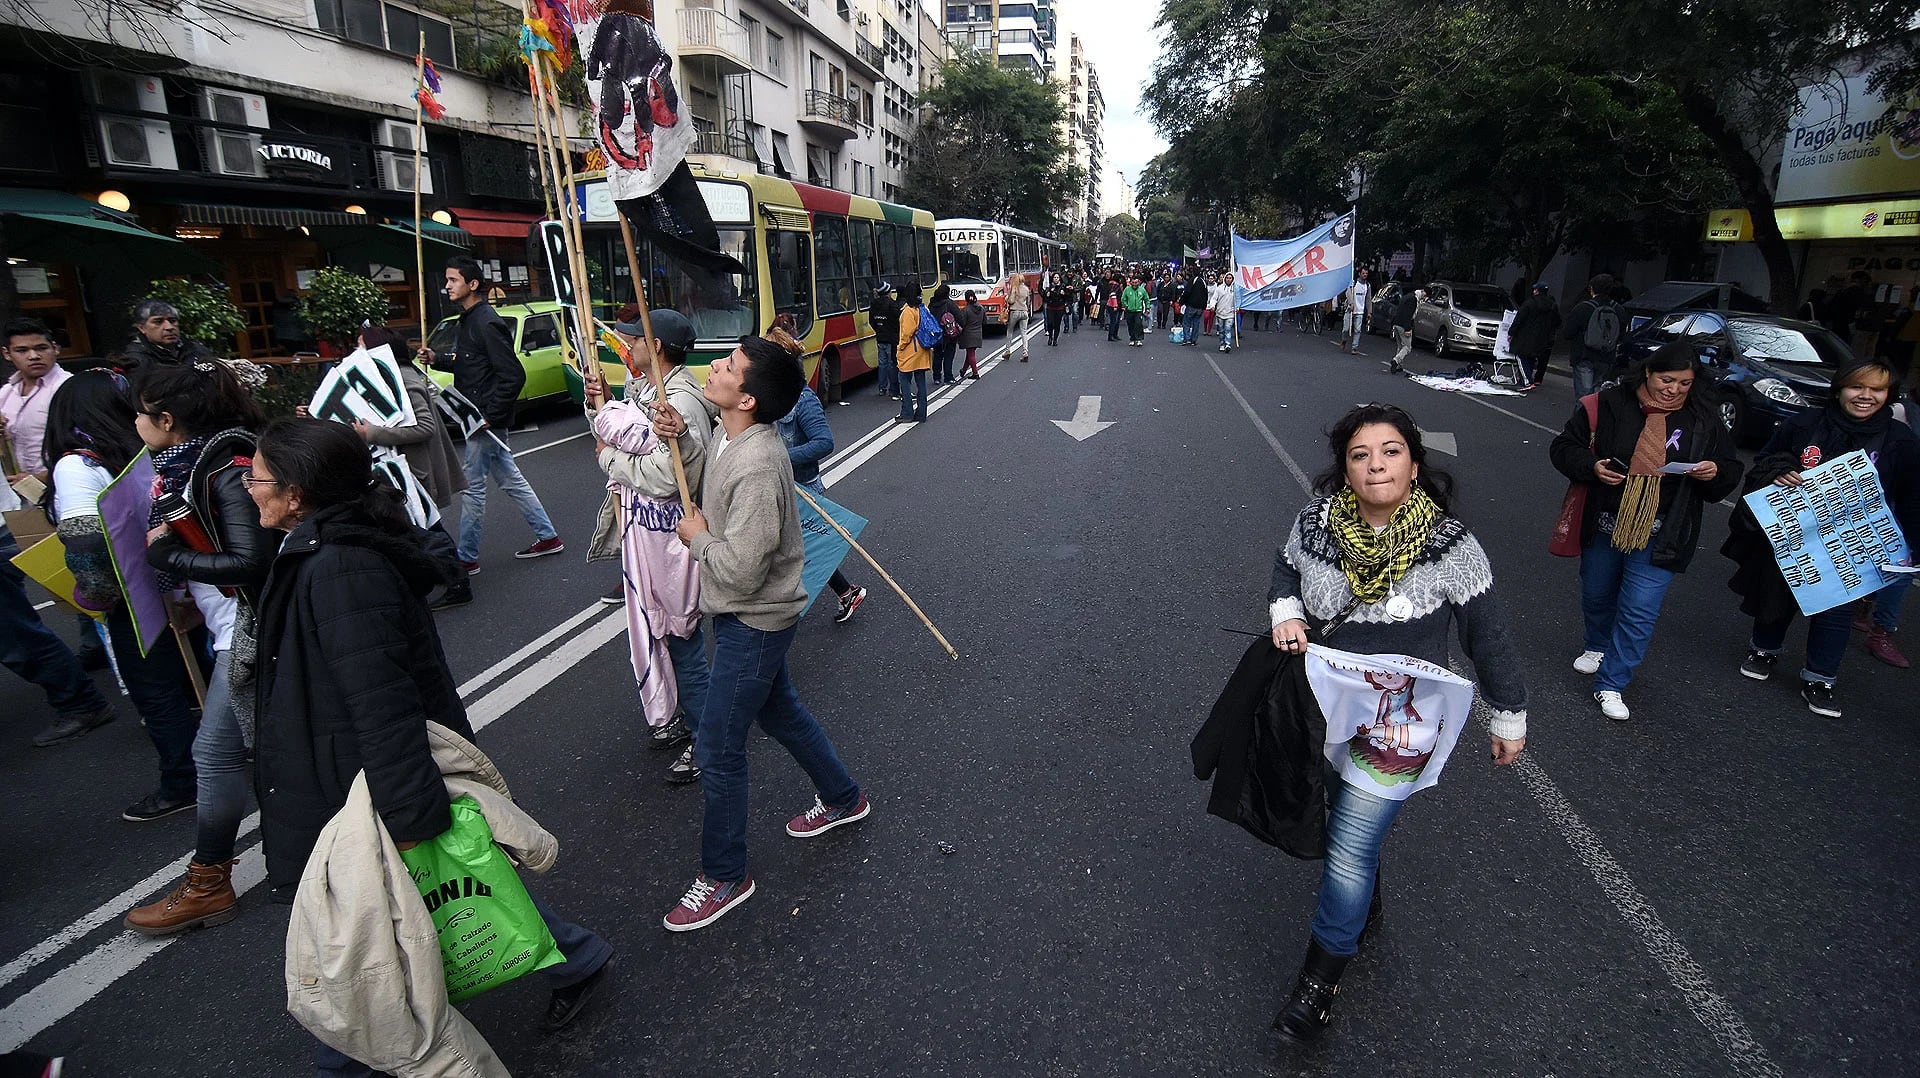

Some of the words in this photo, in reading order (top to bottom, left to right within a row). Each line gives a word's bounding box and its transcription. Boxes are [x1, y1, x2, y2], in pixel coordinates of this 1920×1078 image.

[256, 144, 333, 171] VICTORIA
[1789, 155, 1816, 168] todas
[1819, 151, 1834, 163] tus
[1836, 146, 1881, 161] facturas
[936, 231, 994, 242] OLARES
[1781, 486, 1811, 516] ACTUE
[1815, 470, 1834, 485] NO
[1825, 487, 1849, 527] QUEREMOS
[1840, 530, 1869, 565] GOLPES
[1830, 463, 1861, 511] QUEREMOS
[1856, 524, 1877, 544] NOS
[1847, 454, 1868, 471] NO
[1858, 471, 1883, 514] QUEREMOS
[1871, 514, 1902, 553] FLORES
[1765, 491, 1785, 507] NO
[1777, 507, 1805, 552] QUEREMOS
[1765, 523, 1792, 561] MUERTE
[1782, 565, 1806, 588] MAS
[449, 941, 459, 951] de
[461, 921, 492, 943] Calzado
[458, 948, 494, 973] PUBLICO
[463, 981, 476, 990] SAN
[477, 972, 494, 985] JOSE
[502, 949, 532, 972] ADROGUE
